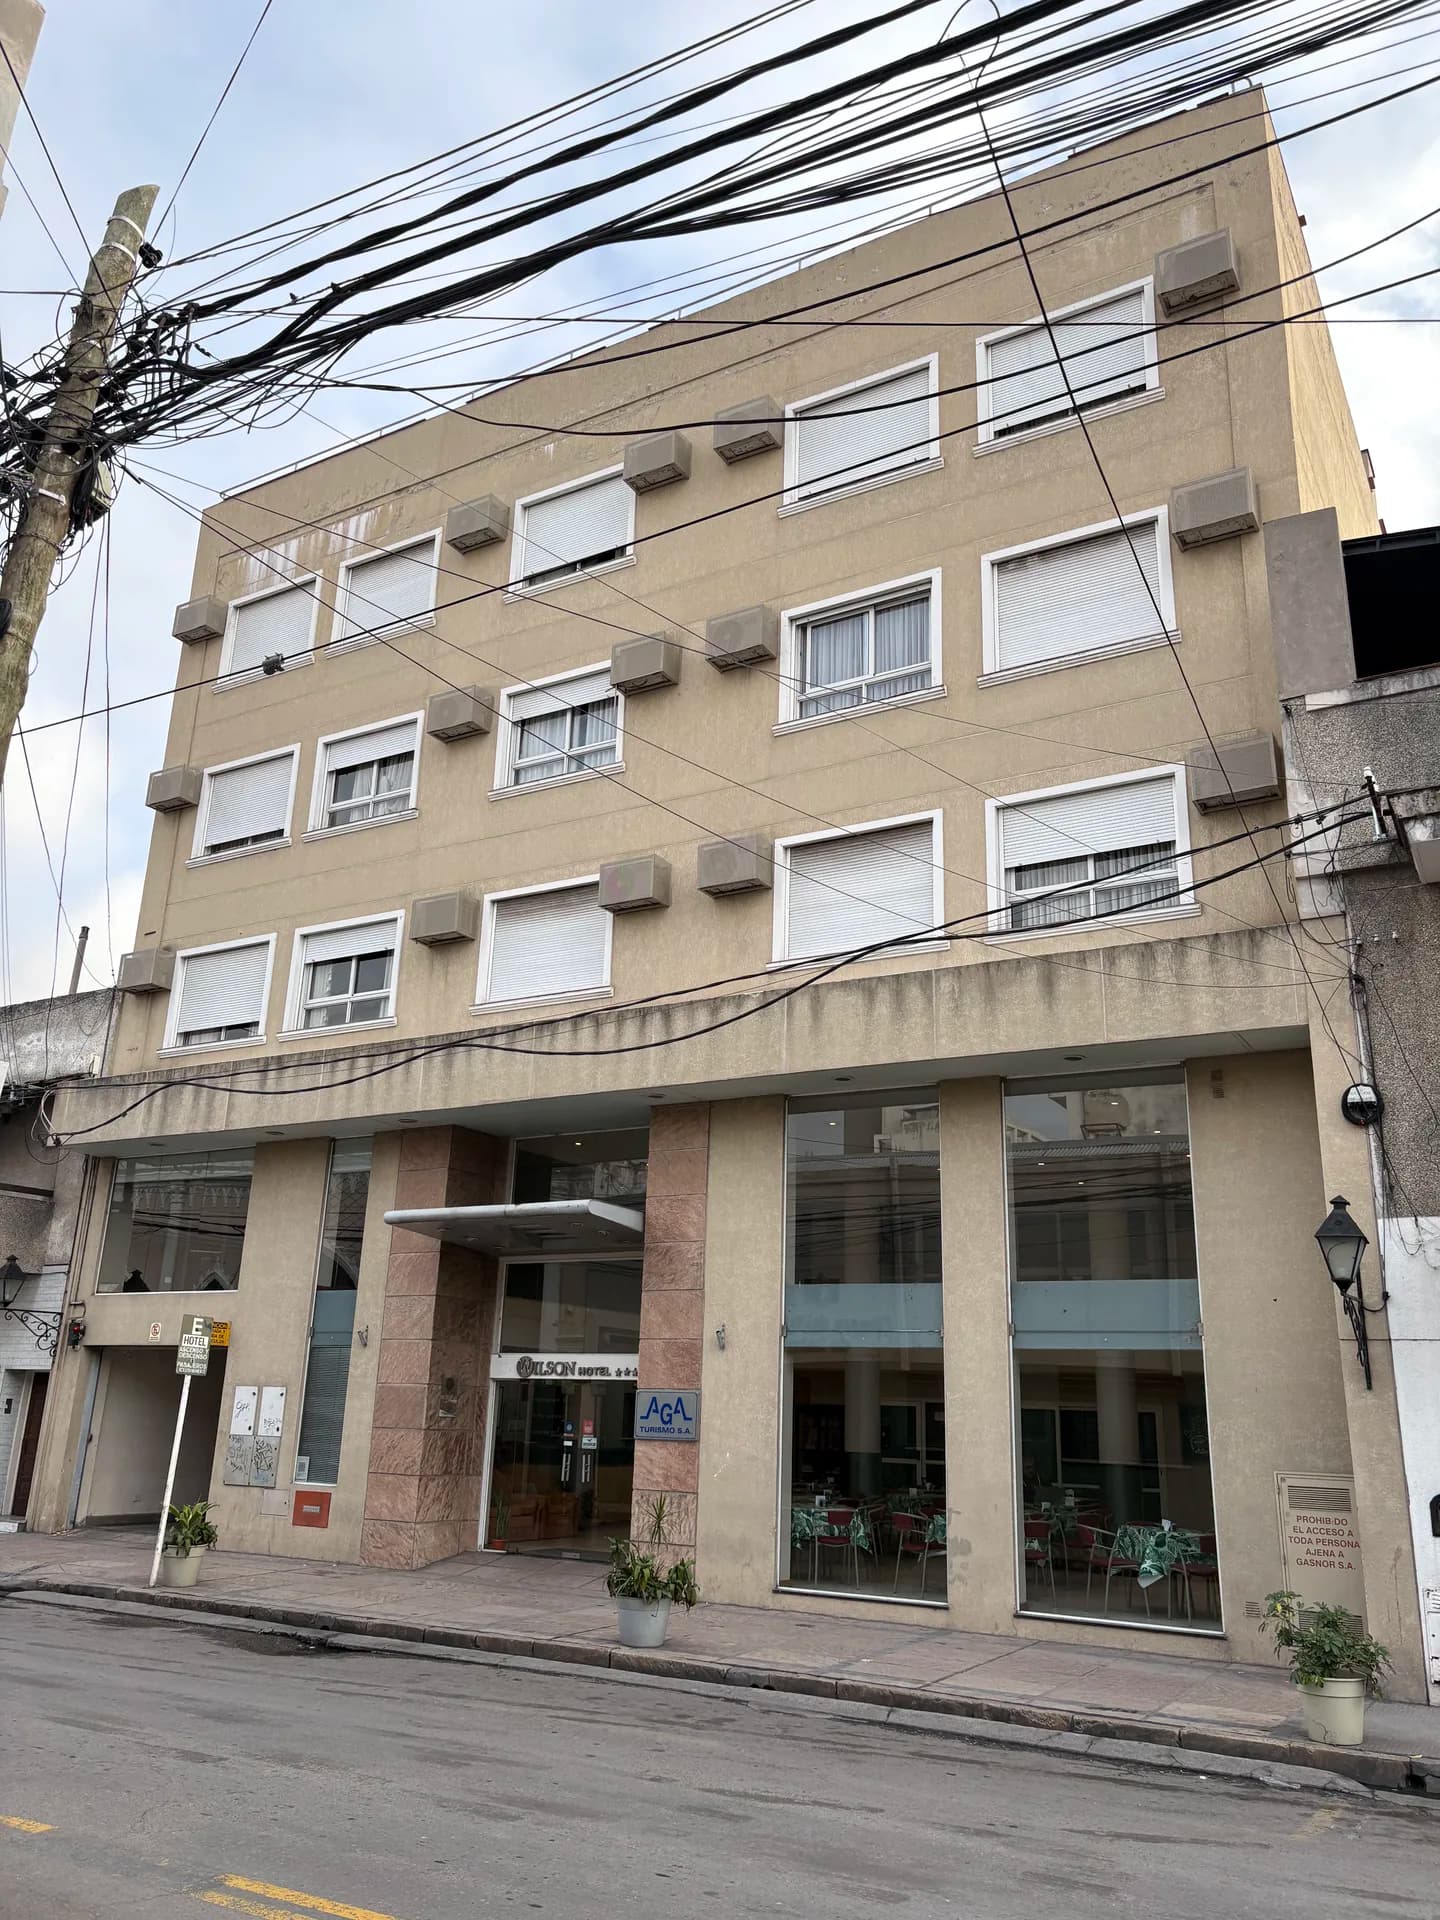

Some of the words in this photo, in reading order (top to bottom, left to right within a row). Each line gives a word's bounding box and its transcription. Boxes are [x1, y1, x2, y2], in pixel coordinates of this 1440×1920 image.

[192, 1317, 204, 1335] E
[183, 1336, 206, 1347] HOTEL
[516, 1356, 577, 1378] WILSON
[577, 1366, 612, 1377] HOTEL
[640, 1396, 693, 1425] AGA
[640, 1426, 675, 1434] TURISMO
[1293, 1525, 1304, 1534] EL
[1306, 1526, 1345, 1537] ACCESO
[1347, 1529, 1354, 1537] A
[1288, 1535, 1313, 1545] TODA
[1315, 1538, 1360, 1548] PERSONA
[1305, 1548, 1336, 1558] AJENA
[1338, 1550, 1345, 1558] A
[1296, 1558, 1336, 1568] GASNOR
[1338, 1561, 1356, 1570] S.A.
